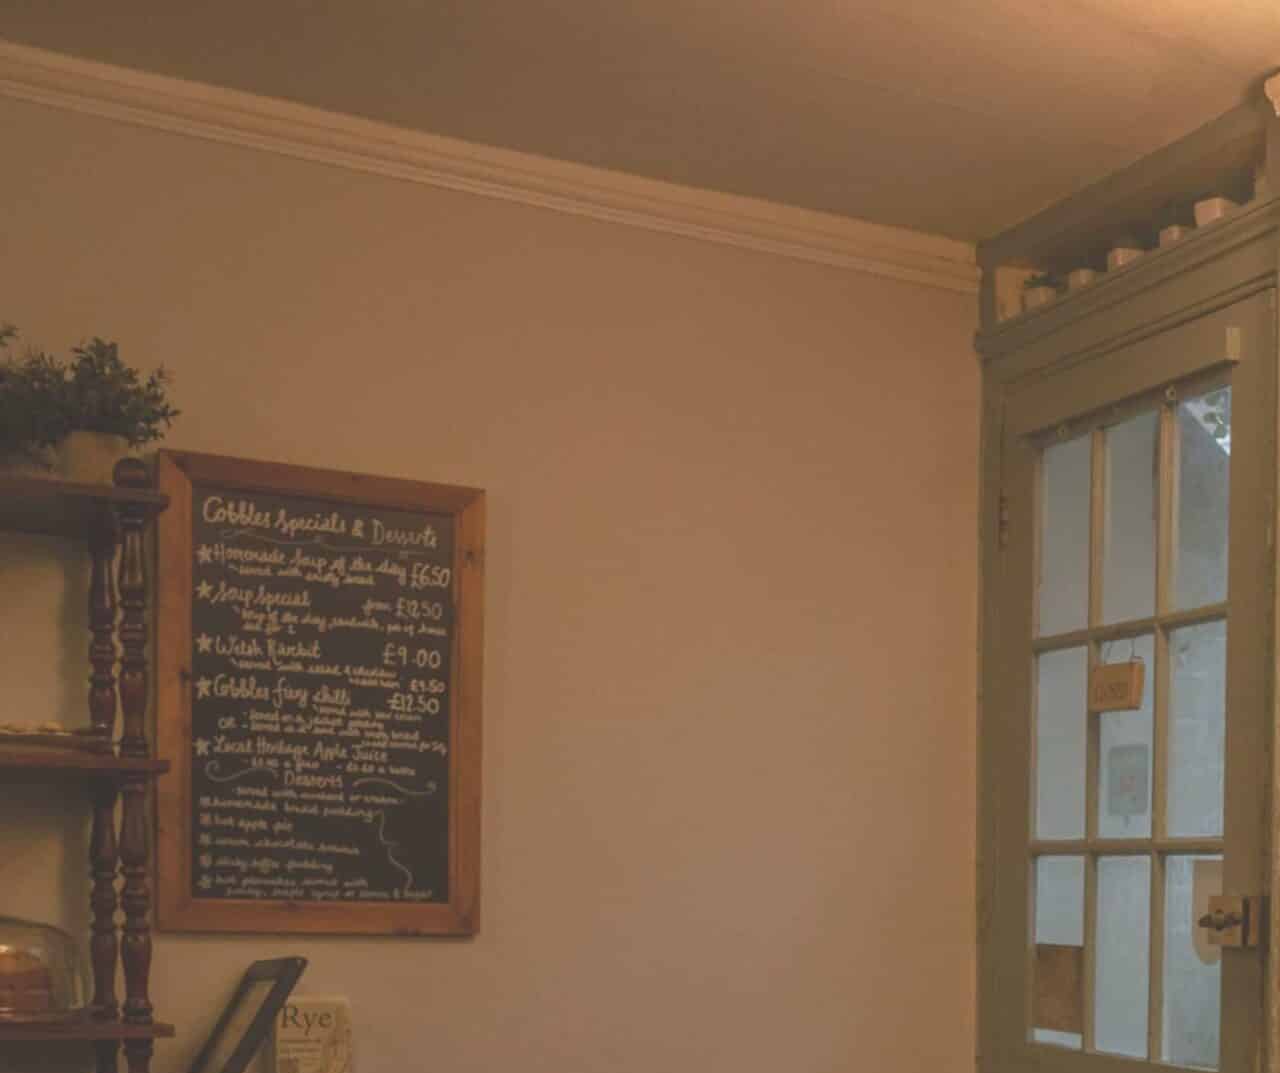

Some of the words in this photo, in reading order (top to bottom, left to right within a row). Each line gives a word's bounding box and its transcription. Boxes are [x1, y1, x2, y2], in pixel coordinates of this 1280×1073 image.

[203, 496, 271, 527] Cobbles
[274, 508, 347, 538] Specials
[372, 519, 437, 549] Desserts
[214, 674, 269, 701] Cobbles
[281, 1005, 333, 1037] Rye
